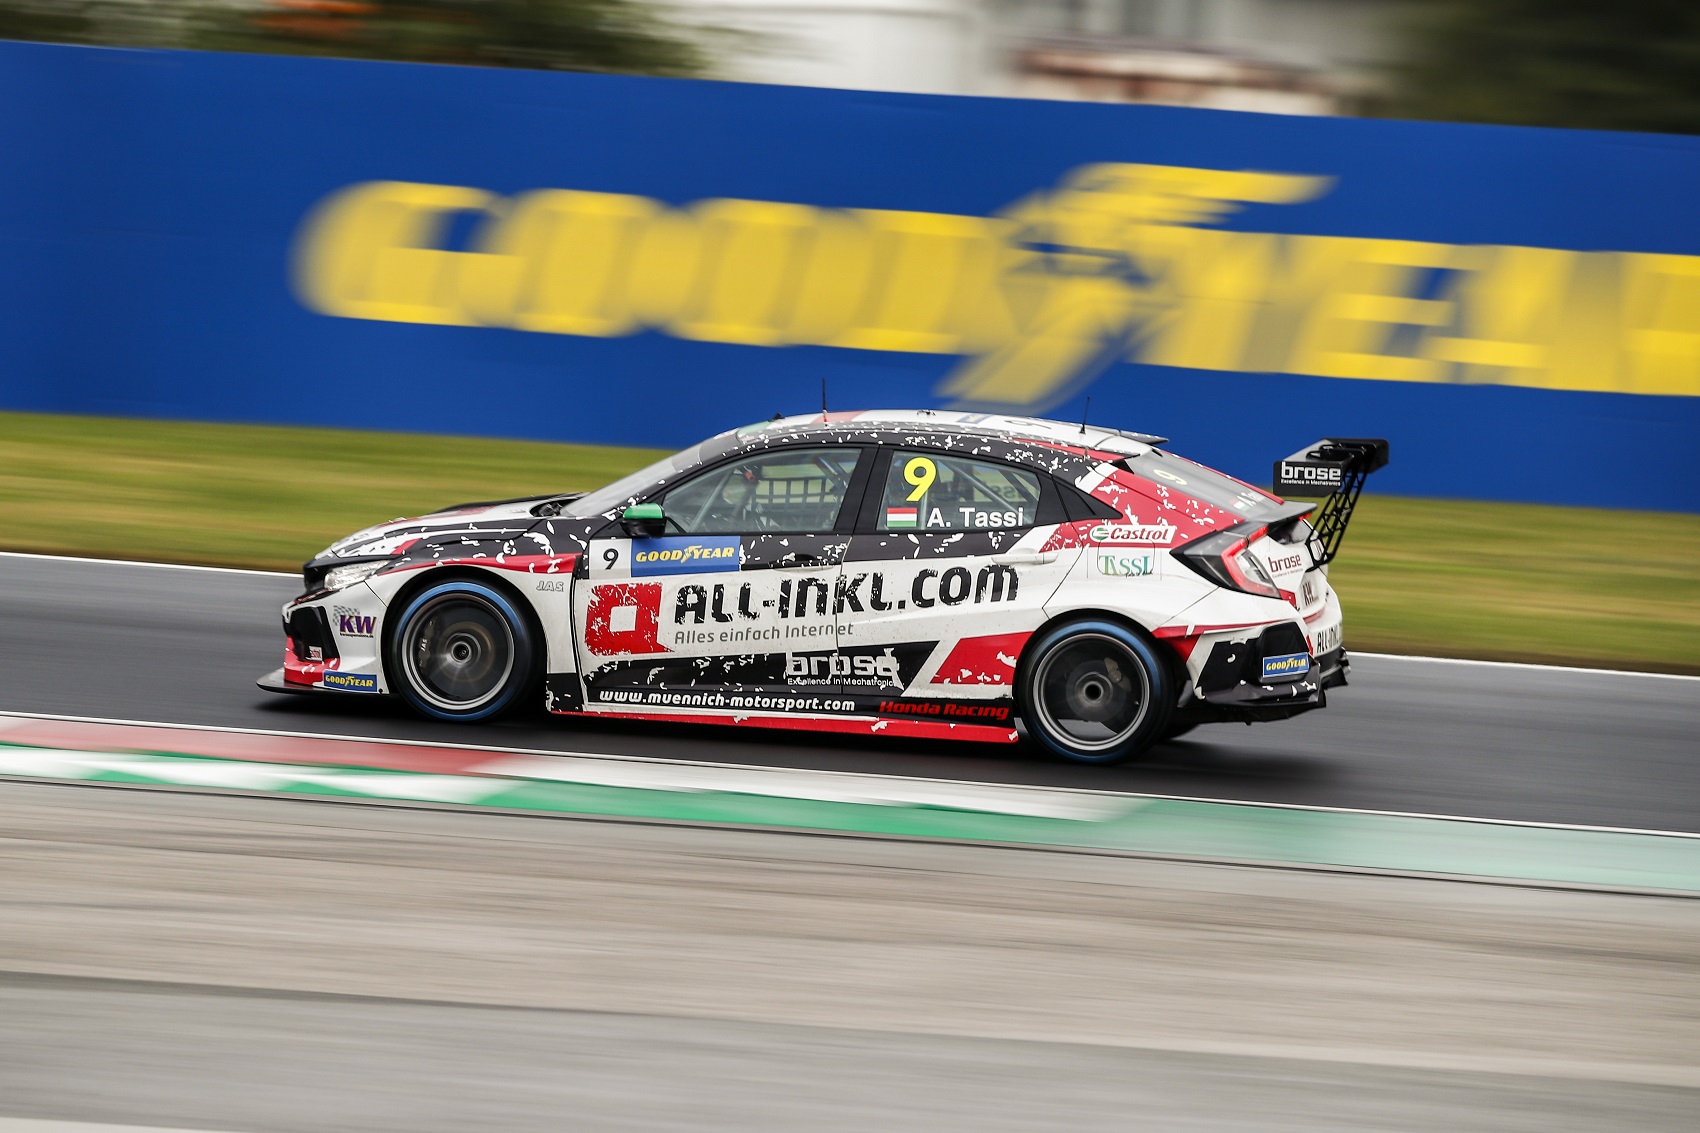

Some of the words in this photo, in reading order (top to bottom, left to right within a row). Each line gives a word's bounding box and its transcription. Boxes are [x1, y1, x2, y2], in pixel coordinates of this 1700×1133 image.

[903, 456, 937, 502] 9
[1281, 461, 1341, 480] brose
[926, 507, 952, 528] A.
[959, 506, 1024, 528] Tassi
[1110, 527, 1169, 540] Castrol
[603, 548, 619, 570] 9
[635, 545, 735, 563] GOODYEAR
[1268, 554, 1302, 573] brose
[340, 614, 377, 634] KW
[674, 631, 715, 645] Alles
[719, 626, 780, 643] einfach
[785, 622, 853, 639] Internet
[785, 650, 900, 677] brose
[1266, 658, 1306, 671] GOODYEAR
[325, 674, 374, 687] GOODYEAR
[787, 678, 831, 686] Excellence
[600, 690, 855, 711] www.muennich-motorsport.com
[878, 700, 940, 715] Honda
[943, 702, 1009, 721] Racing
